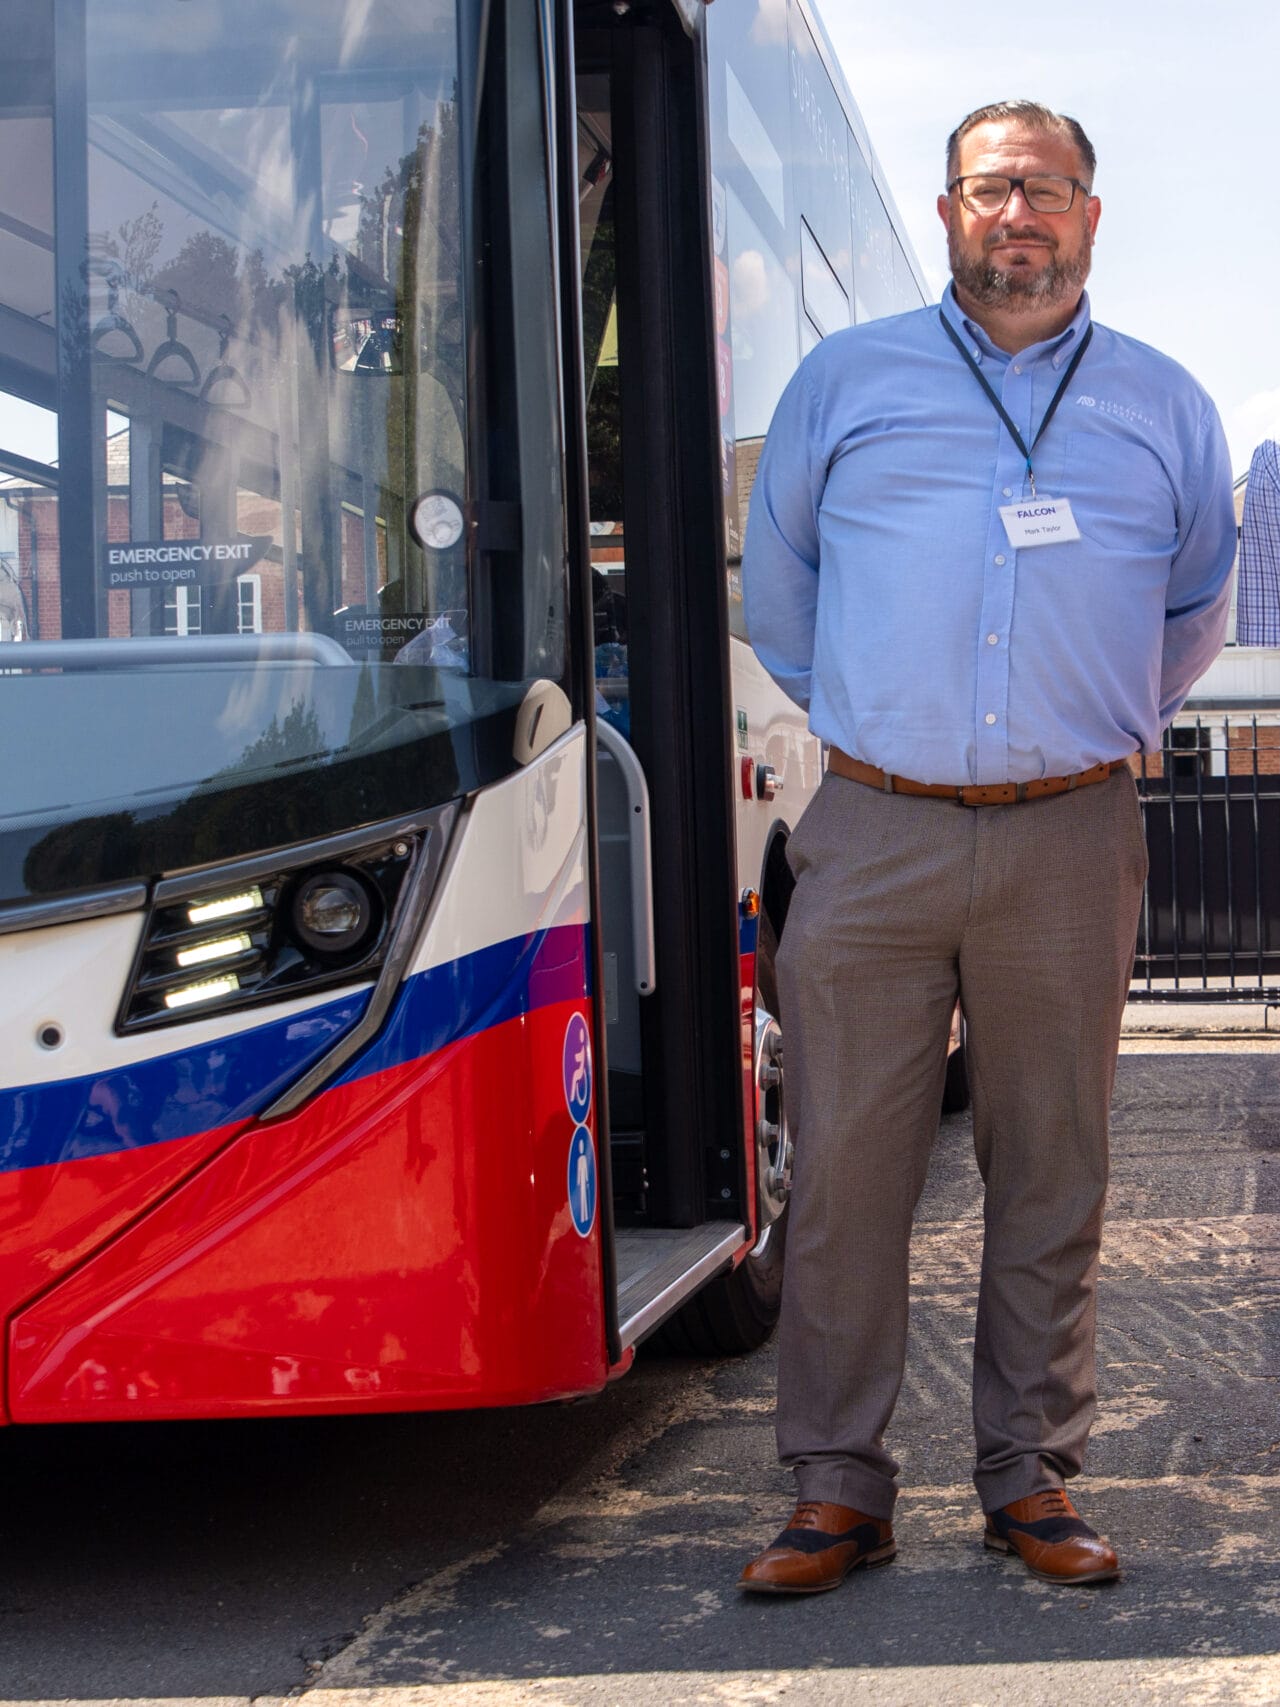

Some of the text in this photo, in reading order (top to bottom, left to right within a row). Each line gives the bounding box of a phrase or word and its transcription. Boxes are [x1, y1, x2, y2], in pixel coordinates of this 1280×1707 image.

[1016, 507, 1056, 518] FALCON
[108, 544, 252, 565] EMERGENCY EXIT
[110, 568, 196, 585] push to open
[345, 617, 452, 632] EMERGENCY EXIT
[346, 635, 405, 646] pull to open
